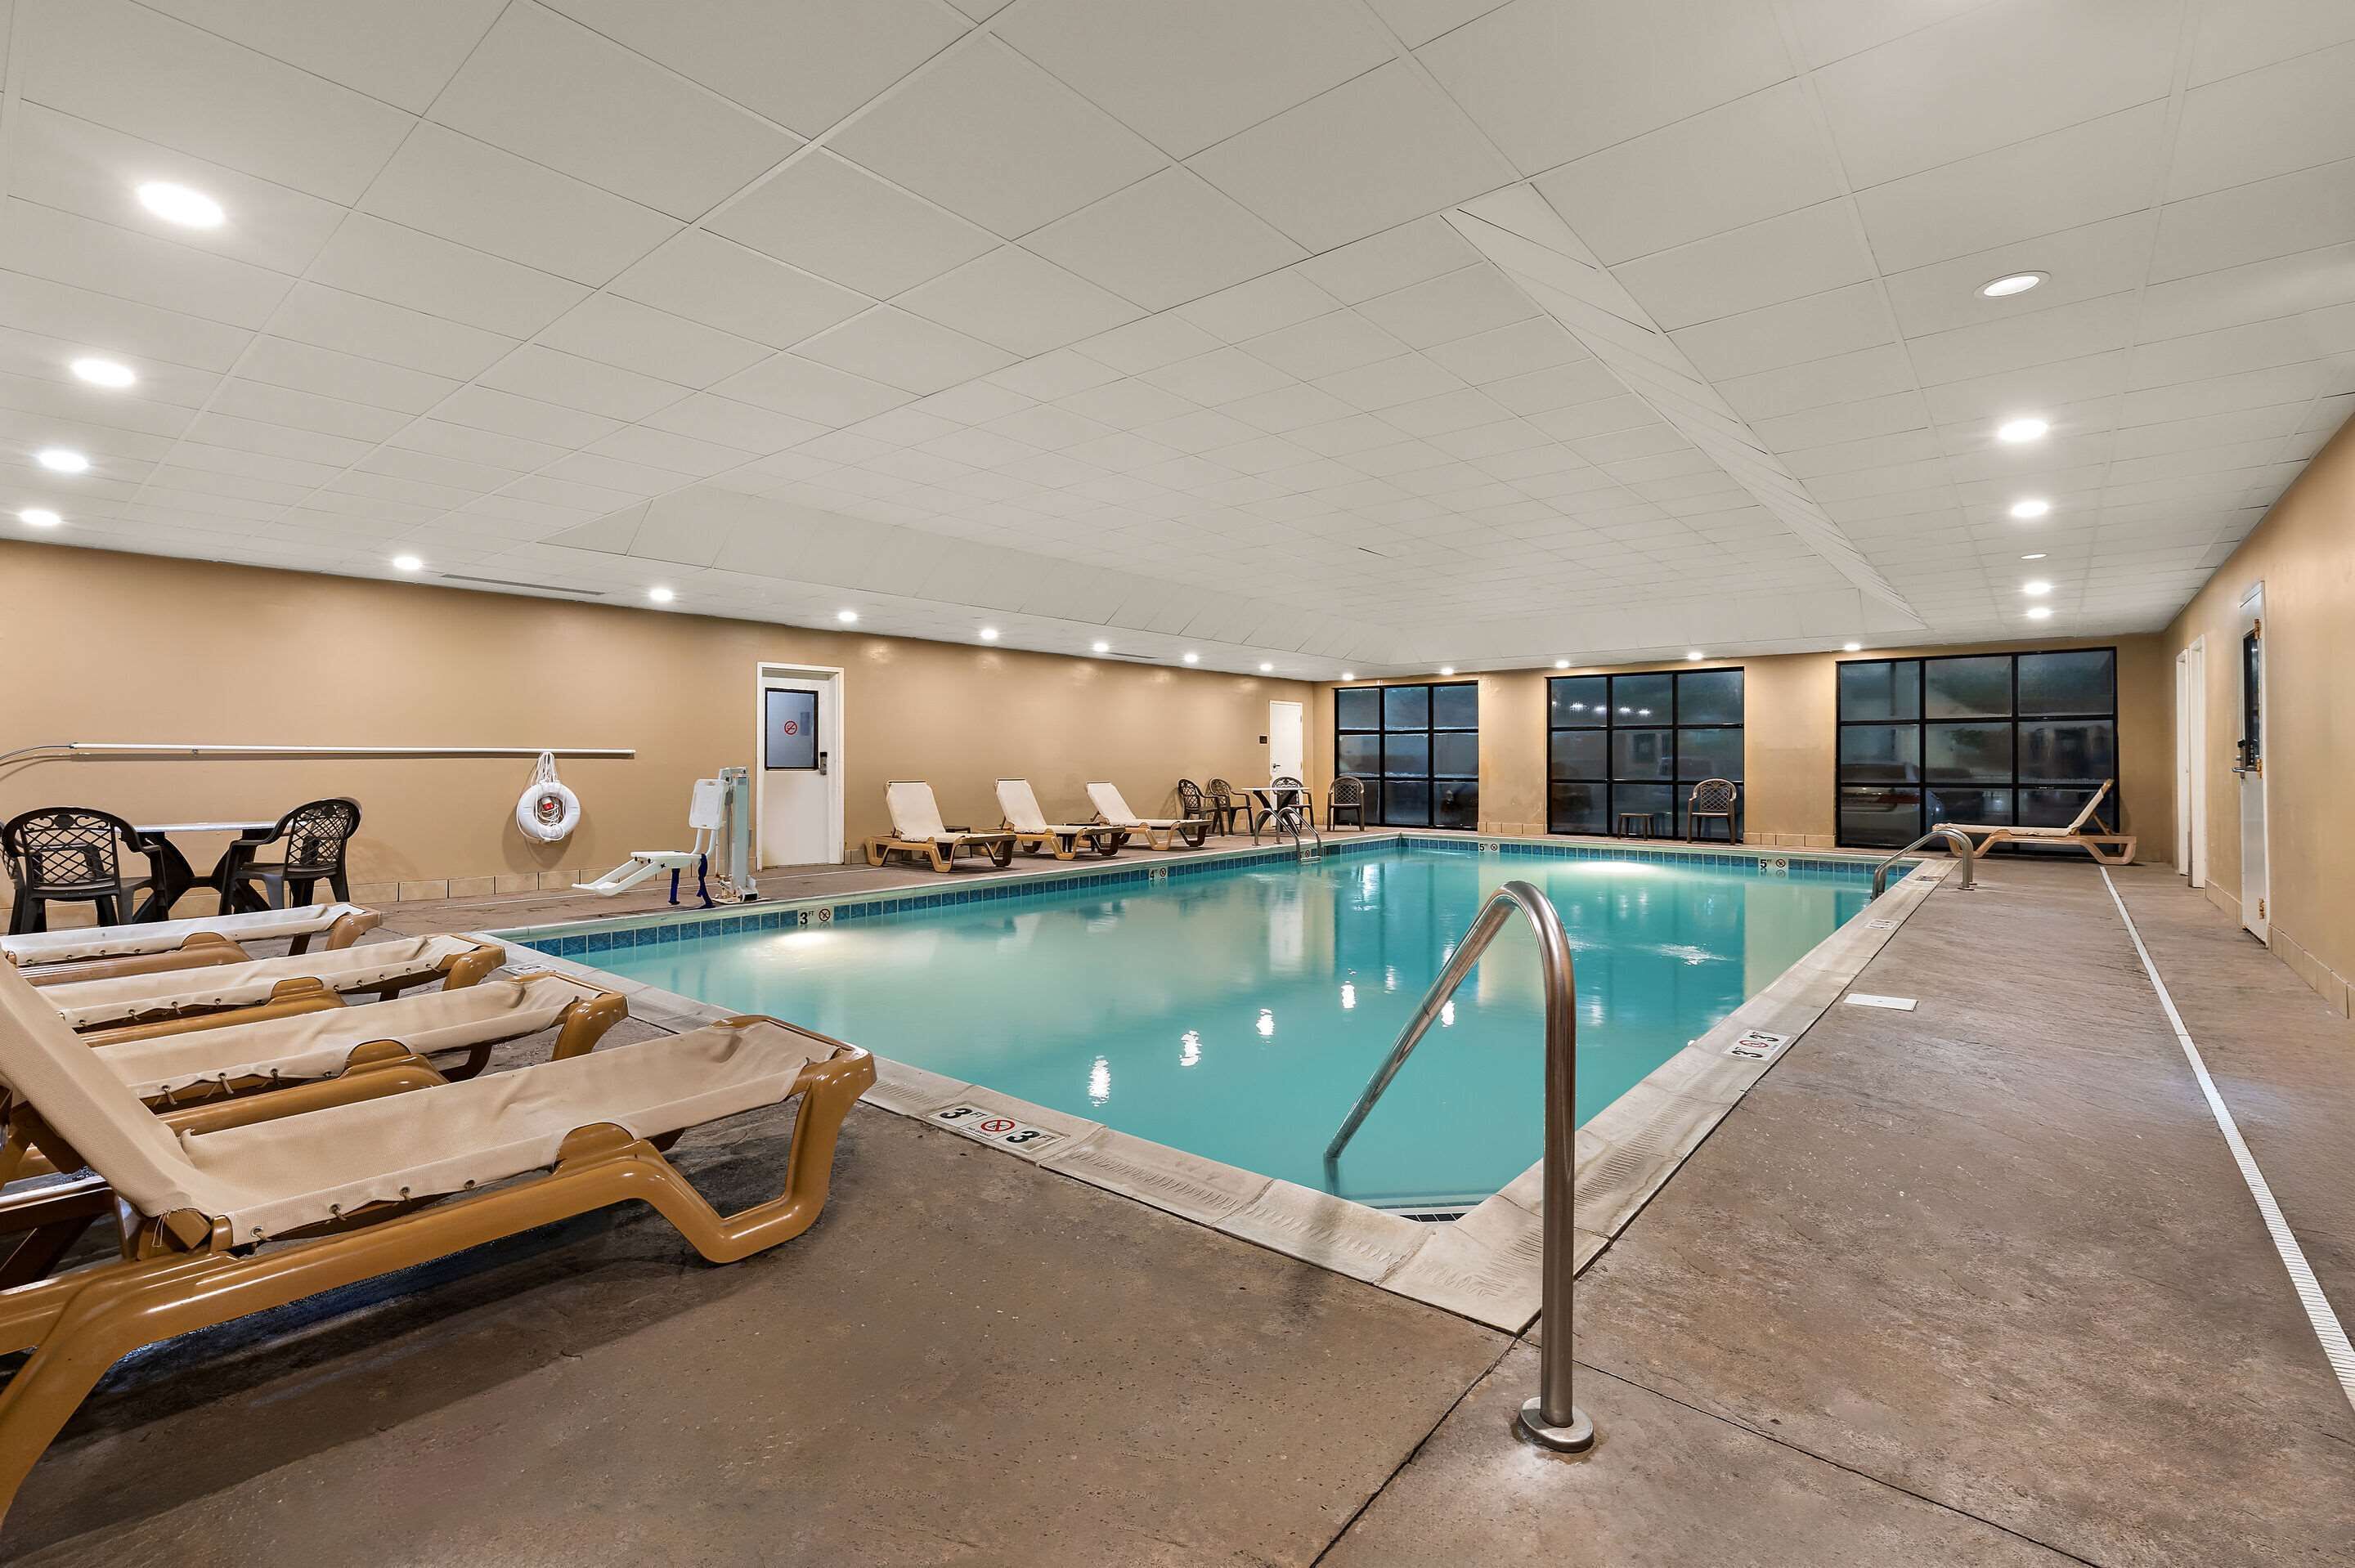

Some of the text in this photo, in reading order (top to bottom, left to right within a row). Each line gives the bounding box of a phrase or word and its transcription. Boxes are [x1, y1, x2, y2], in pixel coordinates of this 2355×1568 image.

[1760, 859, 1767, 868] 5
[800, 912, 808, 925] 3
[940, 1108, 973, 1119] 3
[1006, 1131, 1040, 1143] 3
